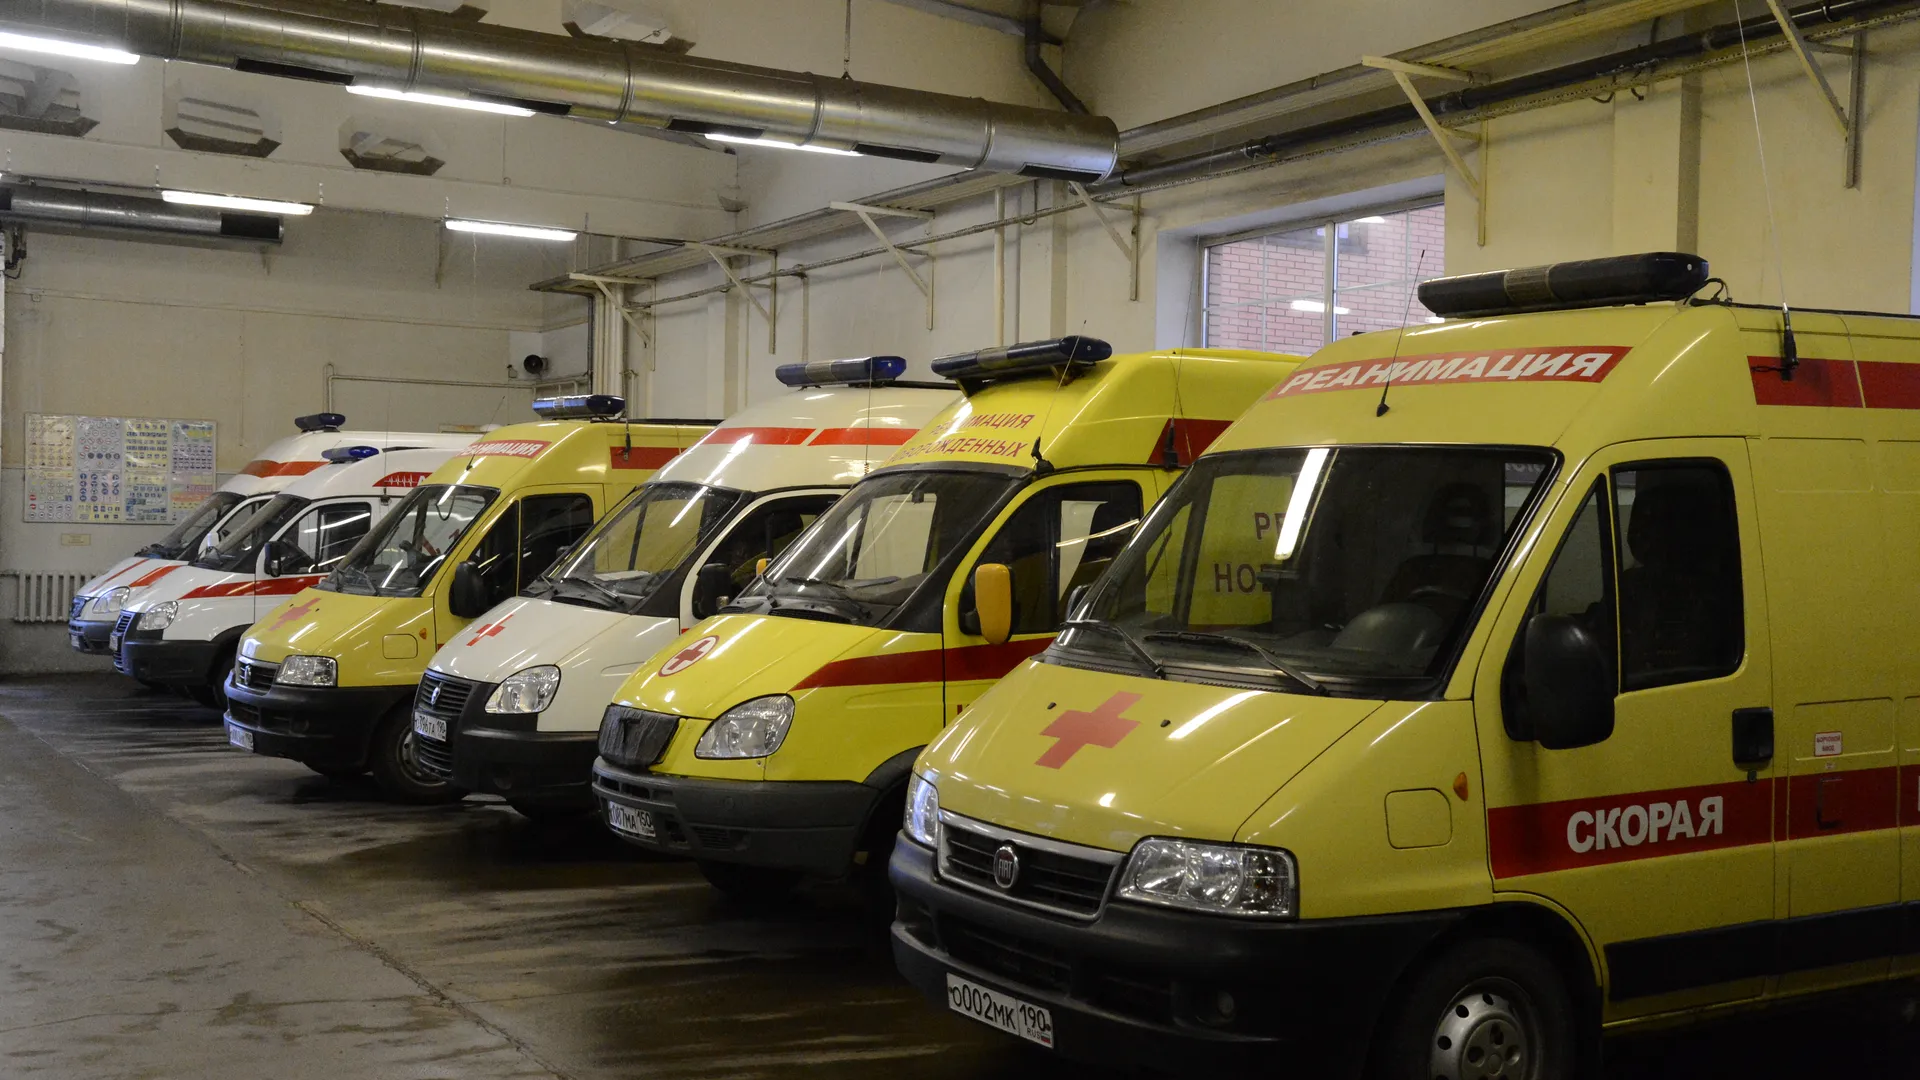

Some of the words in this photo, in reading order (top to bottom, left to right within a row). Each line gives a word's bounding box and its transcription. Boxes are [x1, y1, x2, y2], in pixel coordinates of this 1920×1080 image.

[1277, 352, 1613, 395] РЕАНИМАЦИЯ
[1567, 795, 1724, 854] СКОРАЯ
[998, 859, 1012, 879] FIAT
[1026, 1028, 1041, 1040] RUS
